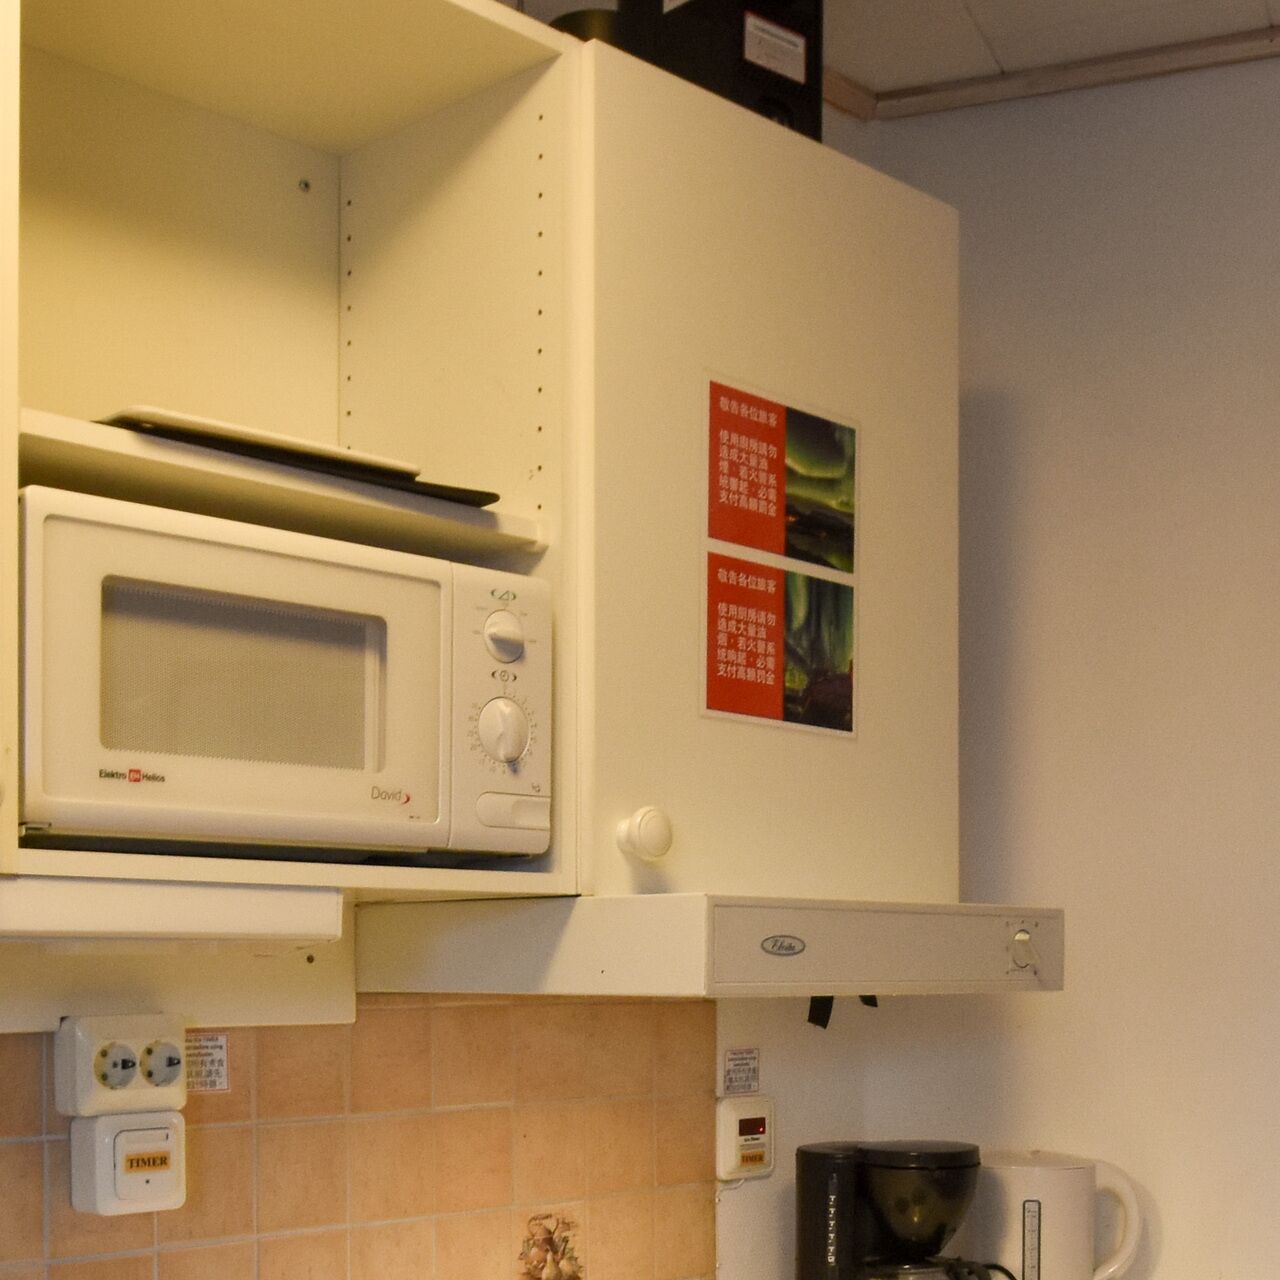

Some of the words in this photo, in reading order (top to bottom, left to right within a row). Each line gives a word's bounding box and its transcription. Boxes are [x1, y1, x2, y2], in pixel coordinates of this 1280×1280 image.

[99, 769, 127, 780] Elektro
[142, 772, 166, 782] Helios
[371, 786, 402, 801] David
[128, 1156, 168, 1169] TIMER
